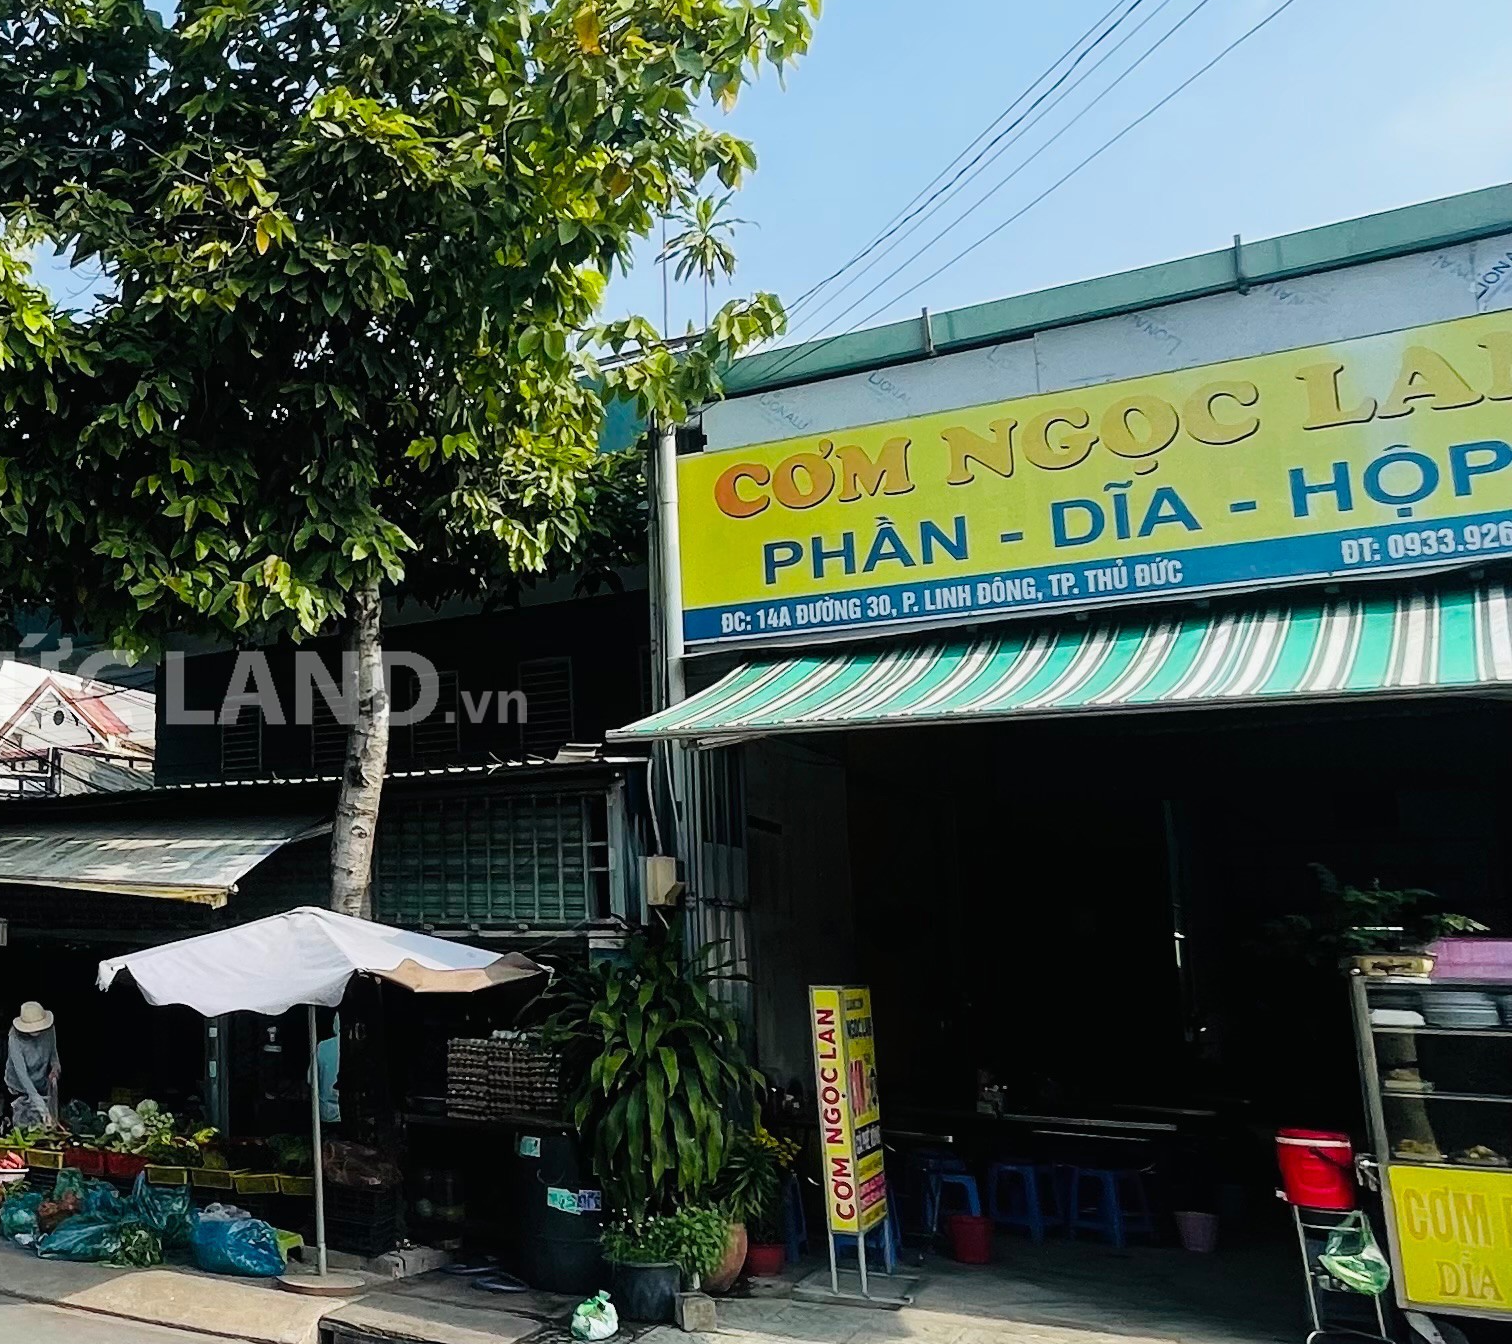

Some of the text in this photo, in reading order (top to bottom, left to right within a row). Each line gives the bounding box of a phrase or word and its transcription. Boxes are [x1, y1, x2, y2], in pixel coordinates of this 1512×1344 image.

[714, 438, 915, 519] CƠM
[940, 381, 1261, 486] NGỌC
[763, 515, 969, 586] PHẦN
[1050, 480, 1202, 548] DĨA
[1288, 440, 1512, 518] HỘP
[1340, 520, 1512, 565] ĐT: 0933.926
[721, 556, 1184, 634] ĐC: 14A ĐƯỜNG 30, P. LINH ĐÔNG, TP. THỦ ĐỨC
[816, 1008, 856, 1221] CƠM NGỌC LAN
[1401, 1185, 1494, 1246] CƠM
